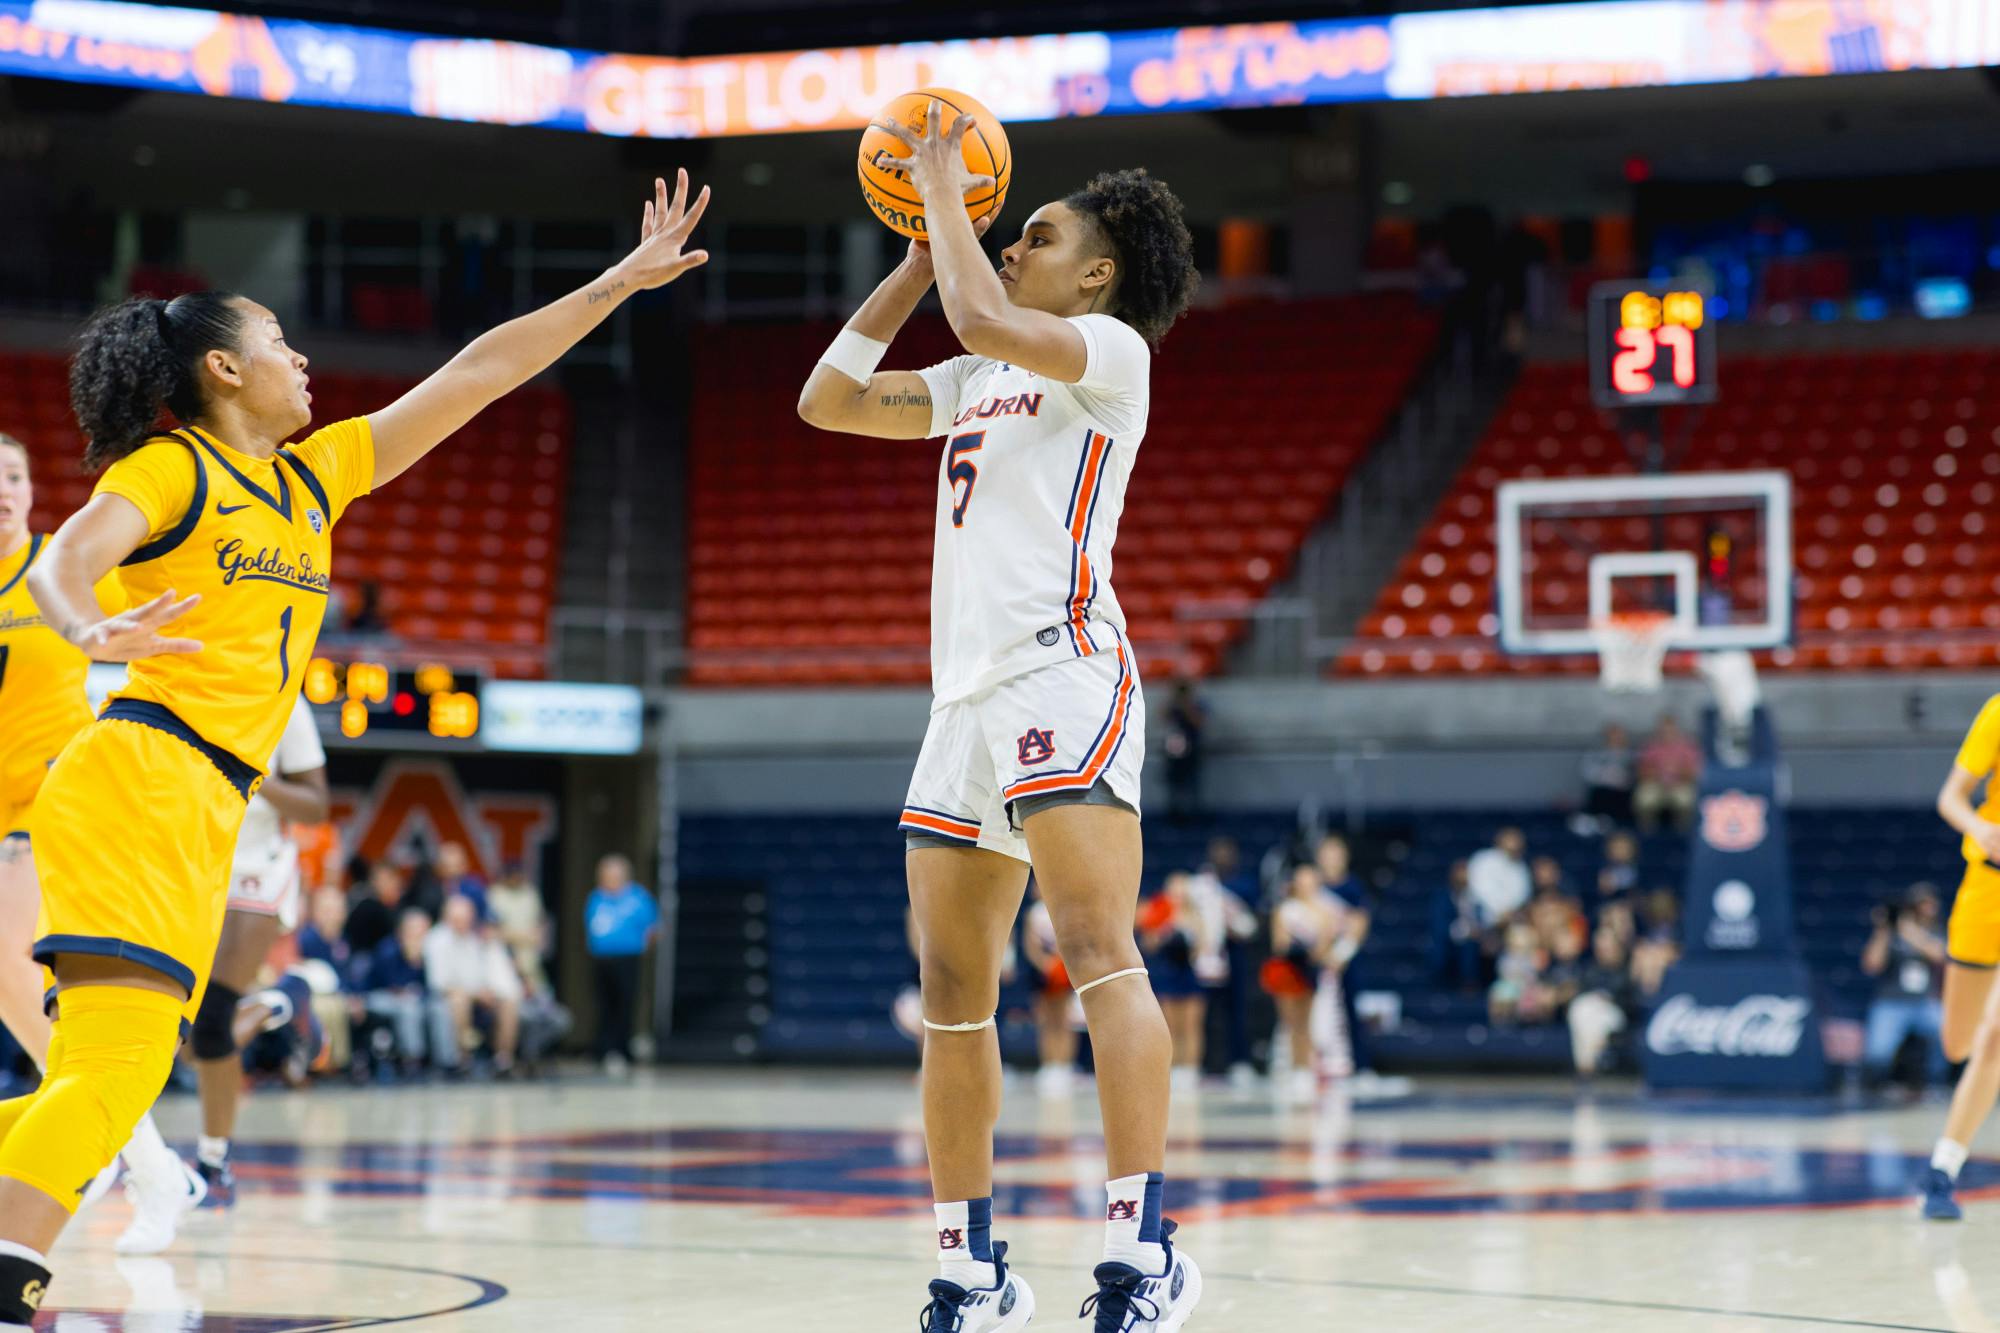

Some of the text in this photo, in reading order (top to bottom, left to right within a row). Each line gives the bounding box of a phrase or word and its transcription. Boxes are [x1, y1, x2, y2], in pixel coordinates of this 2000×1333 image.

[584, 62, 740, 138] GET
[744, 46, 939, 130] LOUD
[1611, 323, 1696, 394] 27
[952, 393, 1044, 427] UBURN
[947, 430, 986, 529] 5
[214, 538, 296, 586] Golden
[277, 605, 293, 693] 1
[1646, 993, 1812, 1056] Coca-Cola
